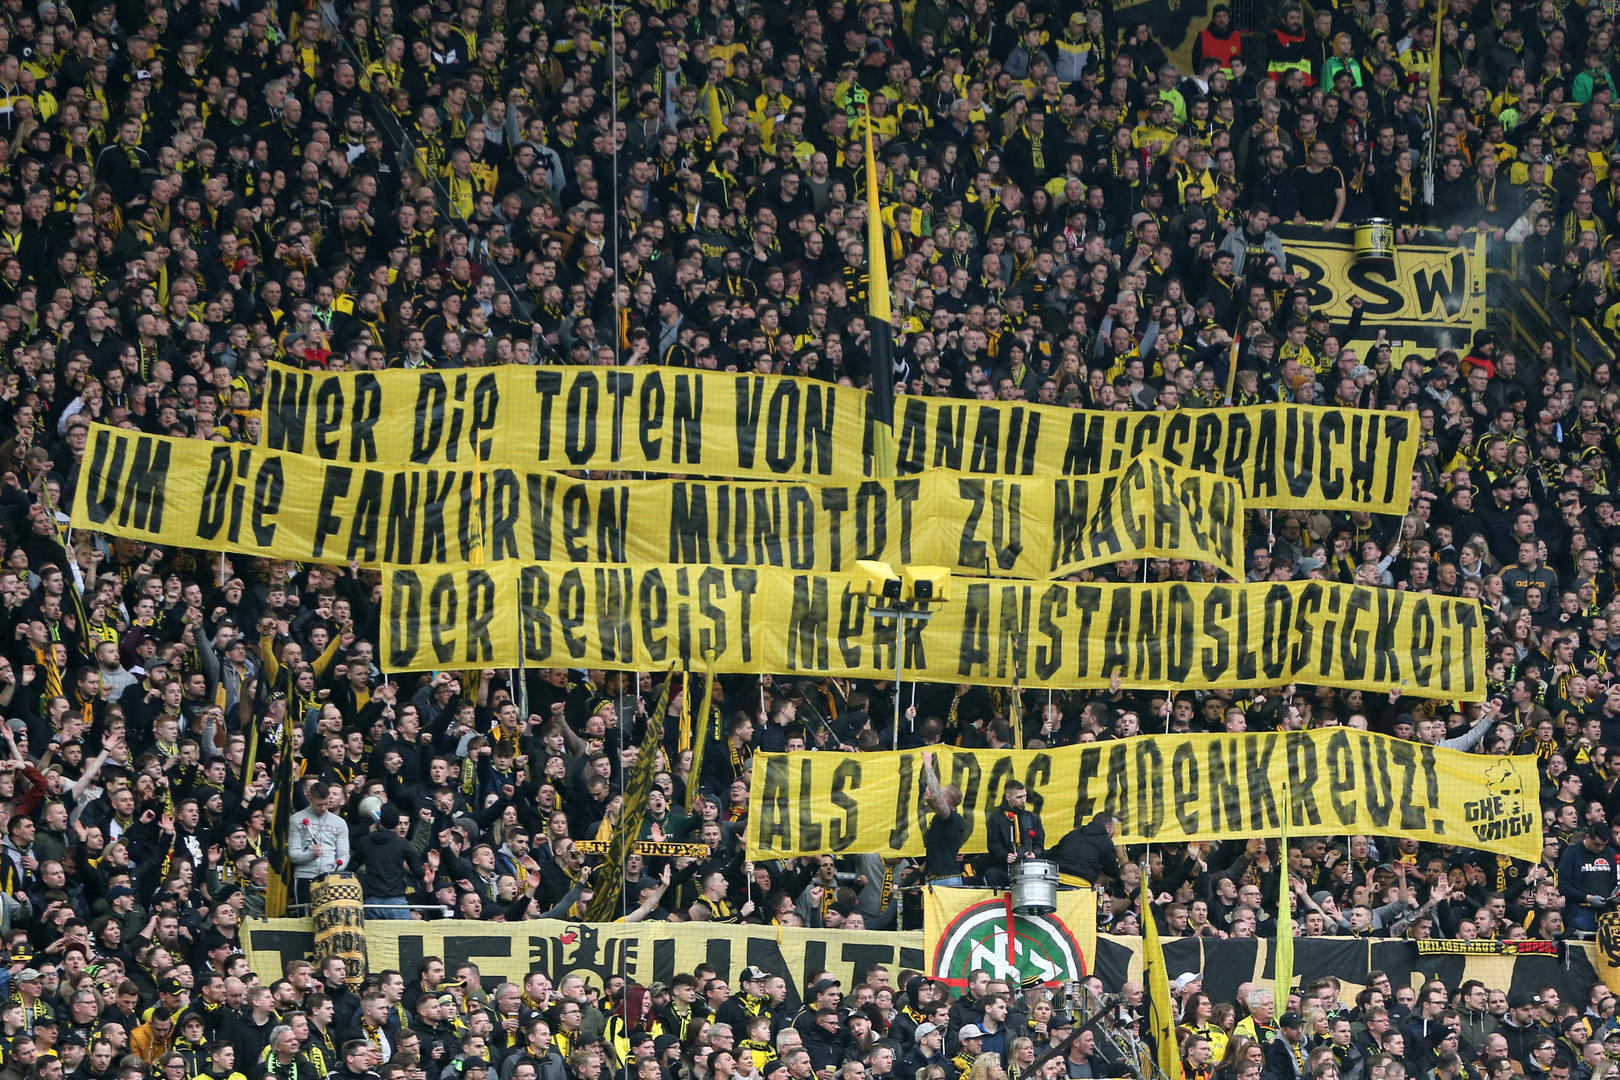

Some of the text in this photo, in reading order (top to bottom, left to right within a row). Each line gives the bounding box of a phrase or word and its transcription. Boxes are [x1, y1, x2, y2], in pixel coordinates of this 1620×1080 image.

[1284, 252, 1466, 318] BSW
[735, 376, 836, 476] VON
[86, 430, 173, 534] UM
[669, 479, 922, 573] MUNDTOT
[958, 478, 1023, 571] ZU
[641, 843, 693, 856] UNITY
[758, 754, 862, 852] ALS
